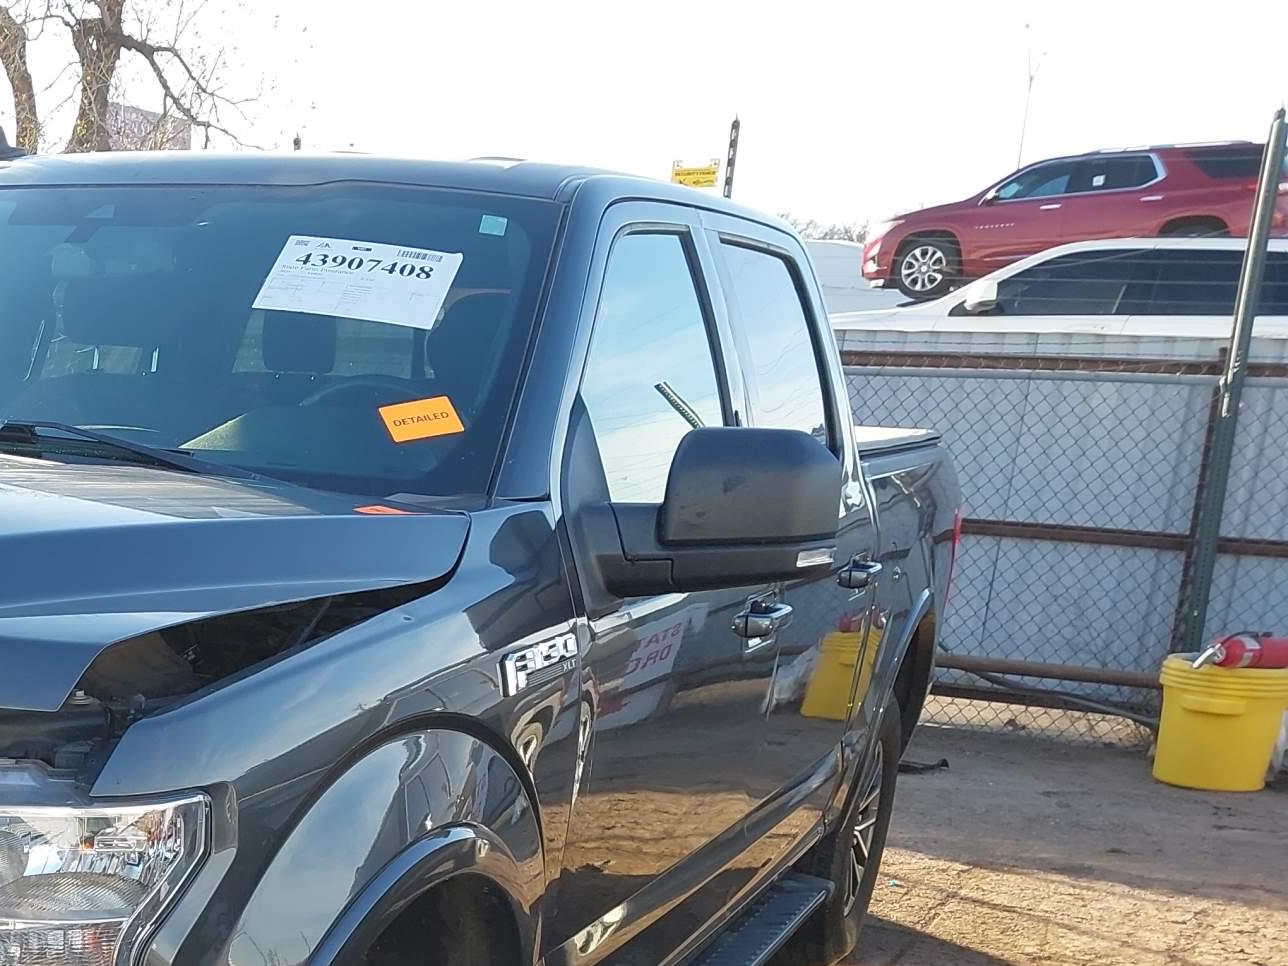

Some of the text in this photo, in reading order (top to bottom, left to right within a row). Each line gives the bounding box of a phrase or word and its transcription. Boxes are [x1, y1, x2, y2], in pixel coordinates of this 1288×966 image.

[295, 252, 435, 280] 43907408
[393, 411, 450, 427] DETAILED
[562, 659, 577, 673] XLT
